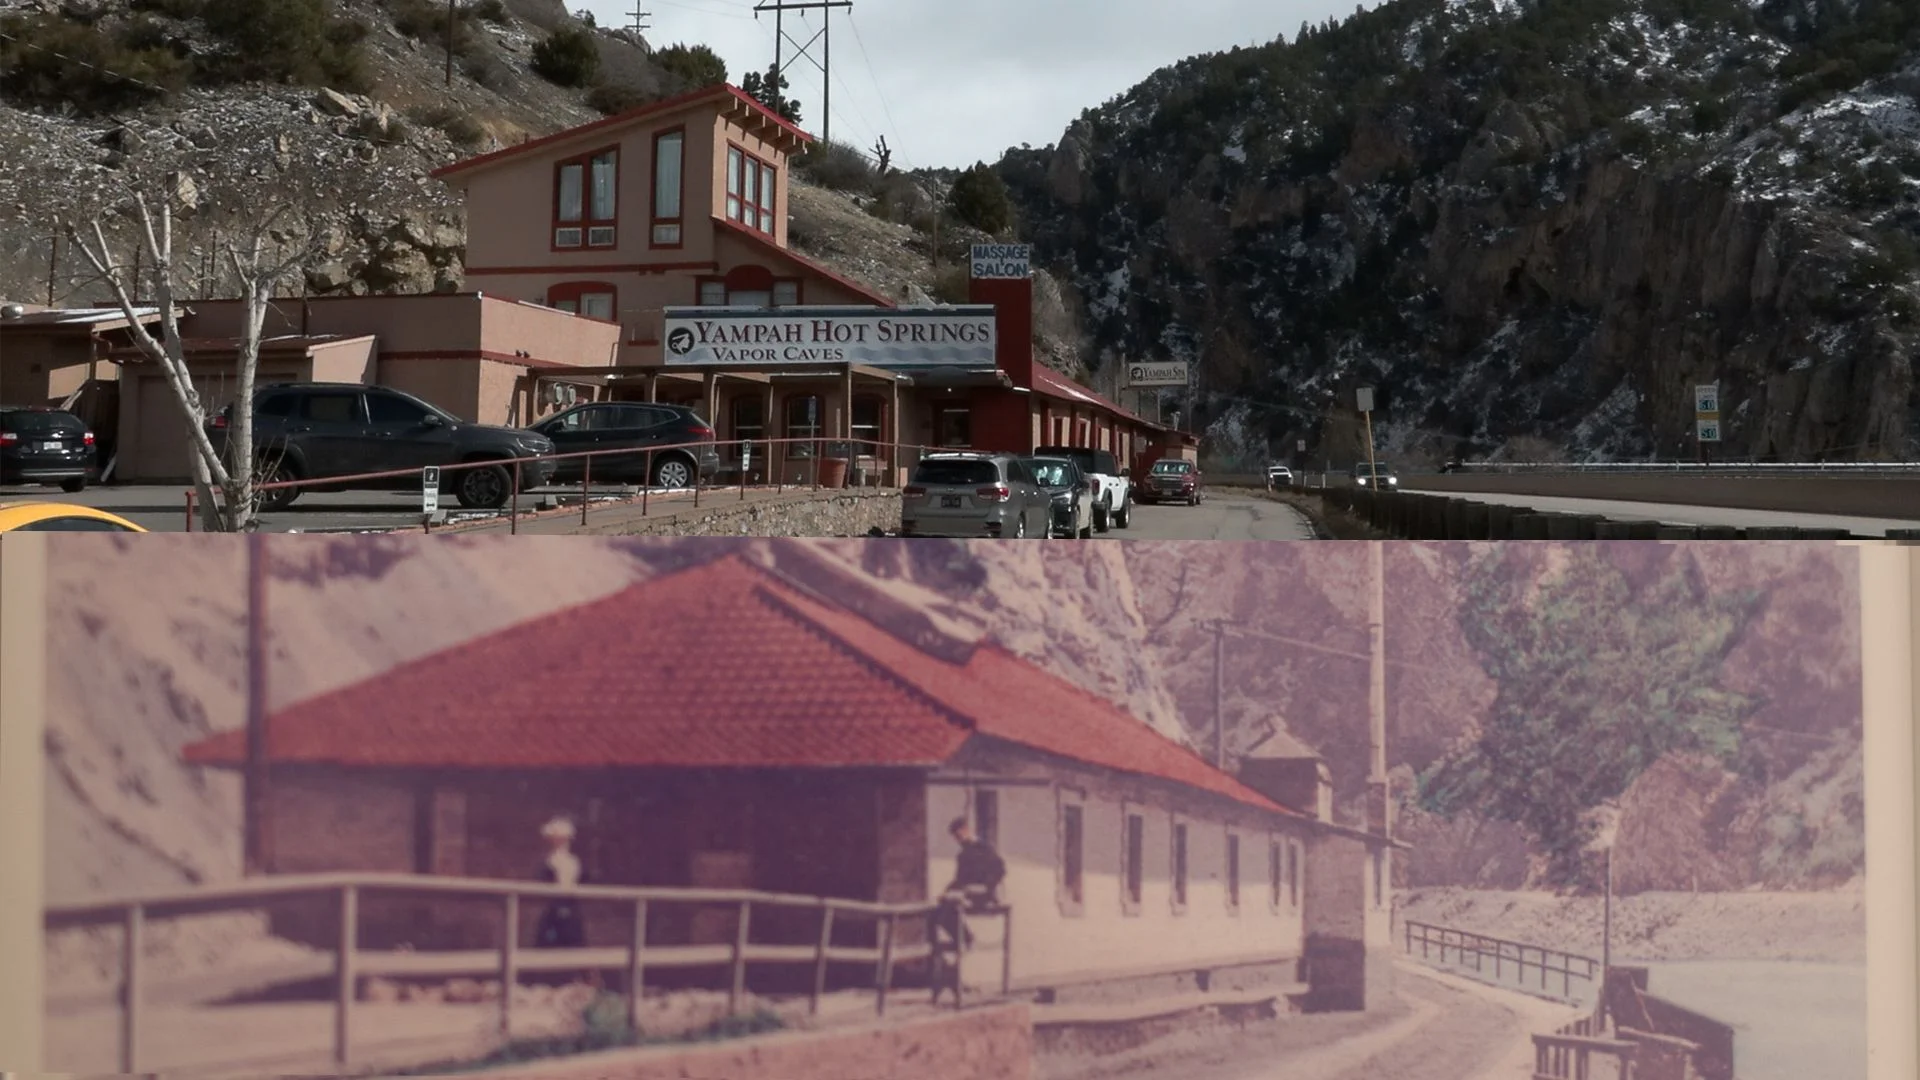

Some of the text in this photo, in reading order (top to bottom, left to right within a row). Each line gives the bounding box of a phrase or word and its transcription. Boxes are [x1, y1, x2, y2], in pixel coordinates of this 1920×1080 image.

[973, 246, 1029, 260] MASSAGE
[973, 263, 1028, 277] SALON
[695, 319, 990, 344] YAMPAH HOT SPRINGS
[712, 346, 844, 361] VAPOR CAVES
